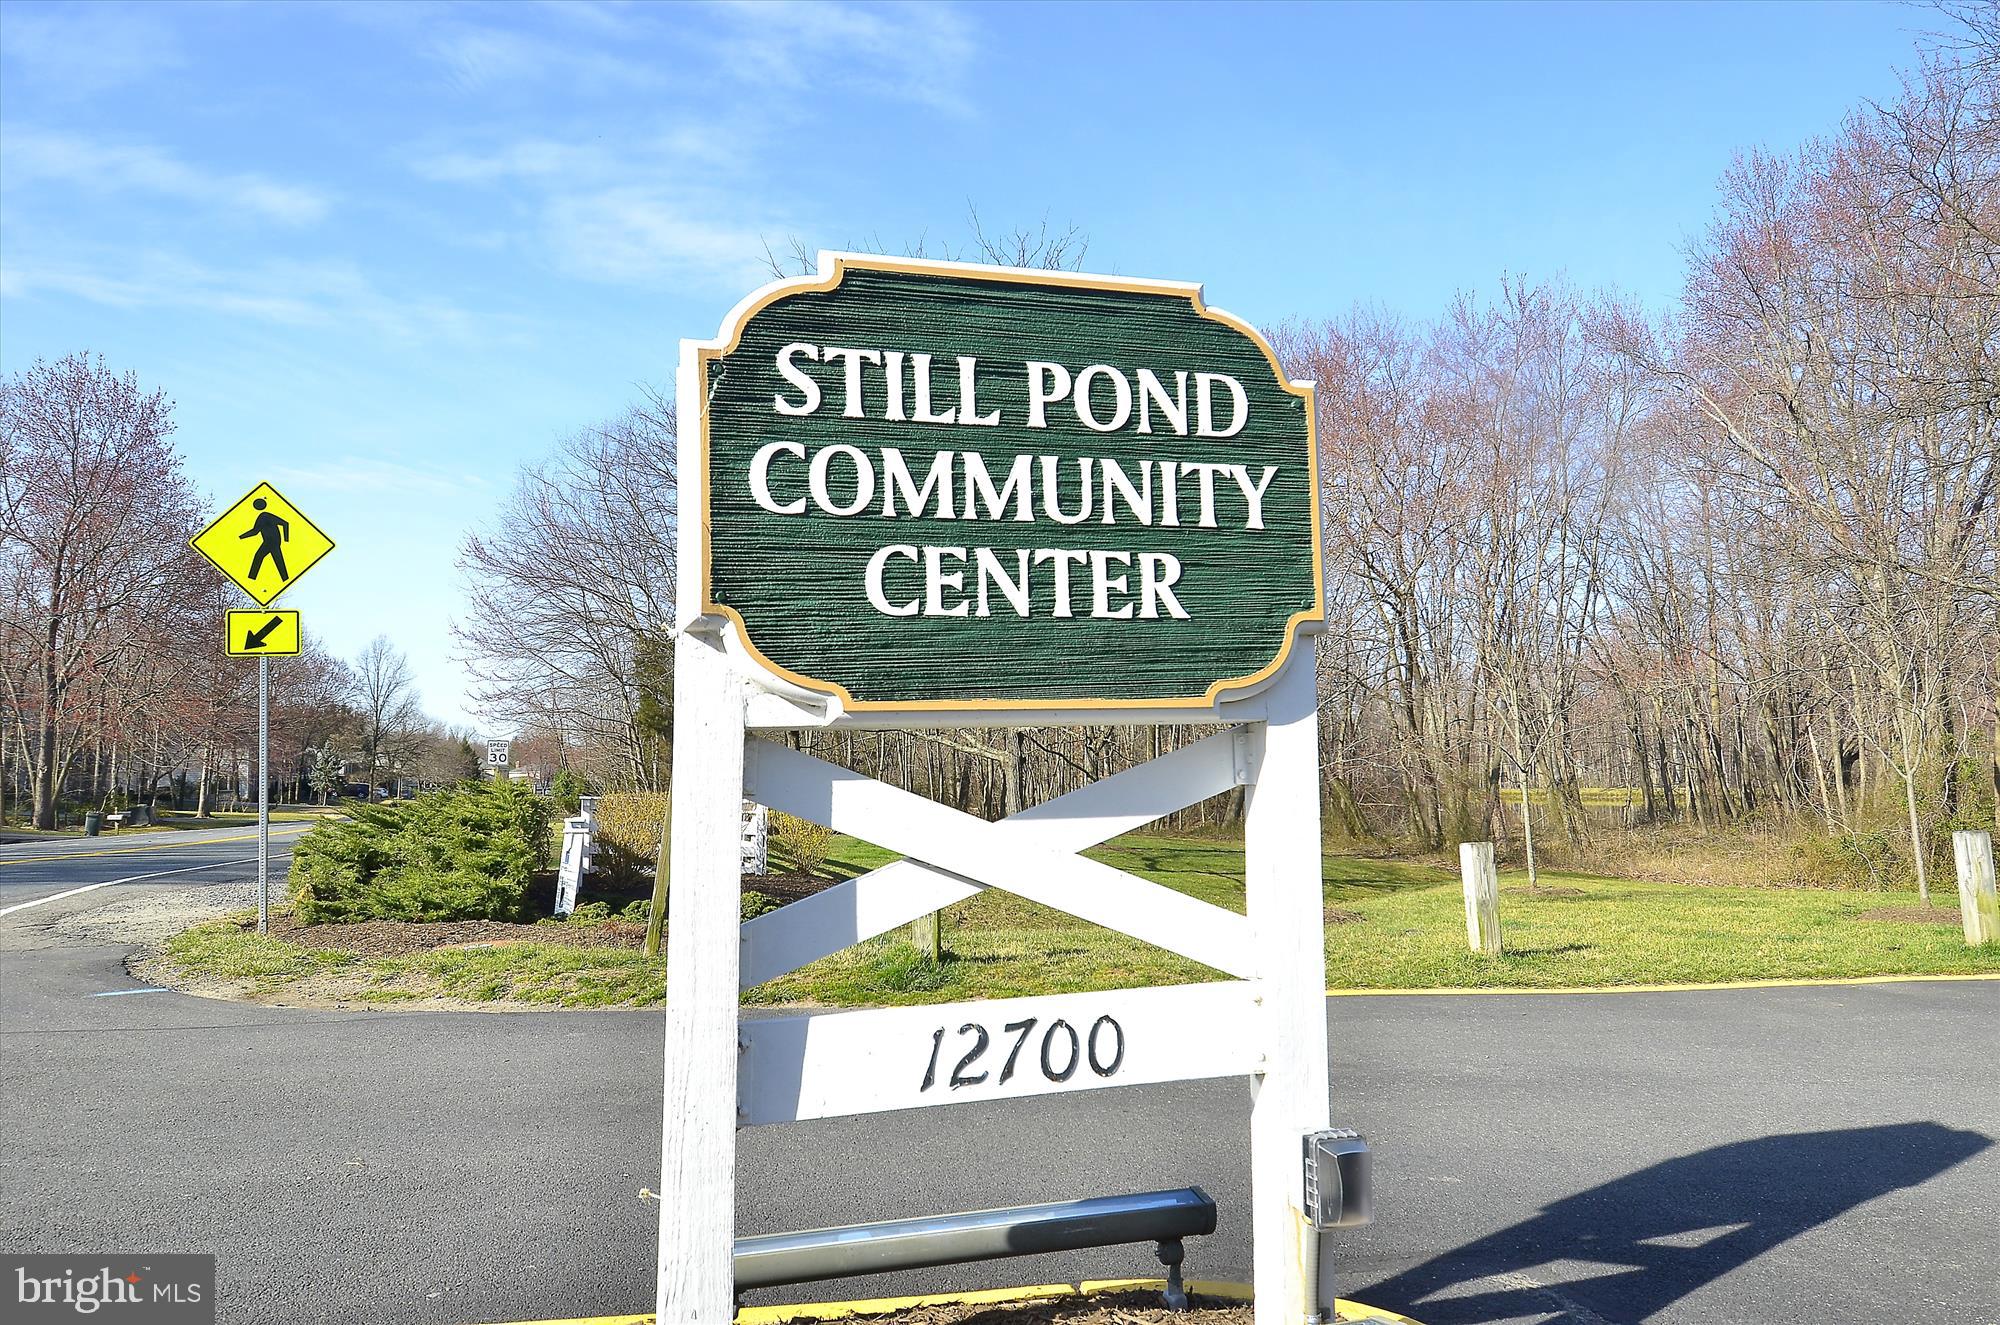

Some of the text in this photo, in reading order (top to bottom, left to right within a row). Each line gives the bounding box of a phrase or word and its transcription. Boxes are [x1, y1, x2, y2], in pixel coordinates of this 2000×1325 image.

[774, 342, 1249, 438] STILL POND
[748, 441, 1278, 530] COMMUNITY
[865, 544, 1191, 620] CENTER
[489, 753, 507, 762] 30
[920, 1014, 1125, 1092] 12700
